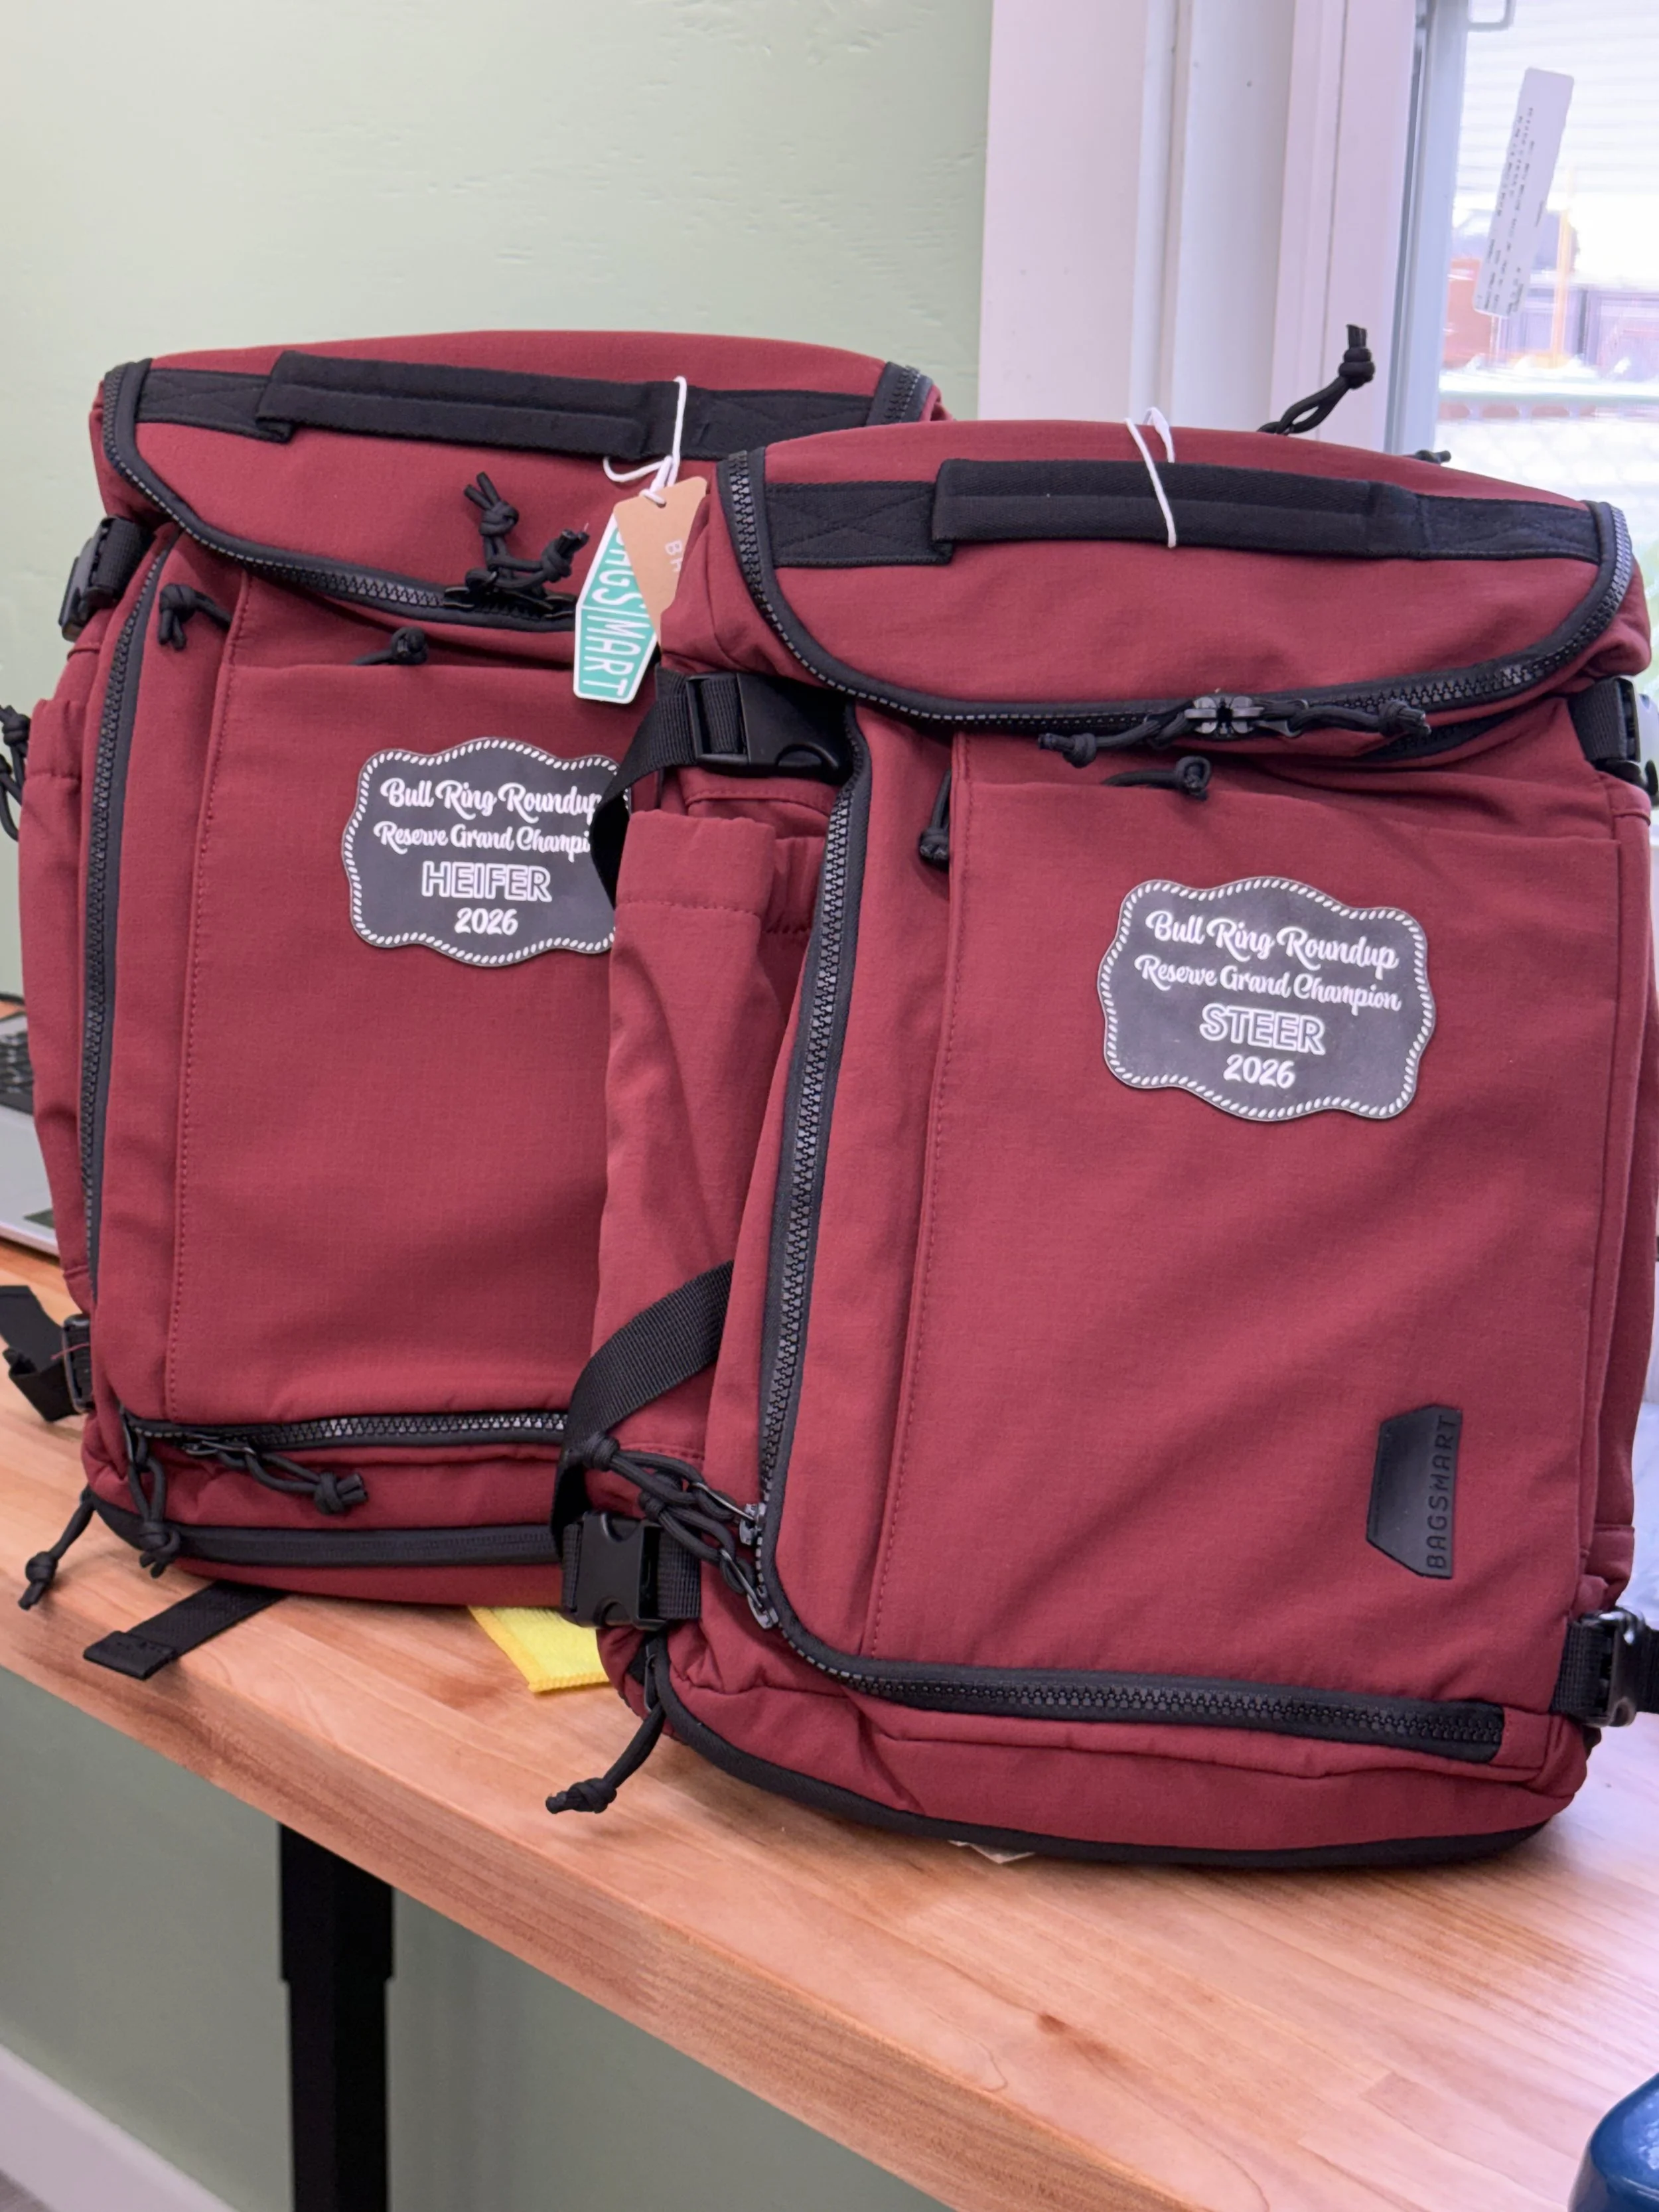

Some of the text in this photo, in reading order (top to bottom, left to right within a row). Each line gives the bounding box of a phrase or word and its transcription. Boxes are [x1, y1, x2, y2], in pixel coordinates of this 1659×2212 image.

[380, 777, 435, 808] Bull
[435, 780, 498, 820] Ring
[373, 820, 449, 855] Reserve
[450, 824, 515, 851] Grand
[421, 860, 553, 903] HEIFER
[454, 907, 518, 936] 2026
[1145, 909, 1400, 980] Bull Ring Roundup
[1133, 954, 1402, 1016] Reserve Grand Champion
[1198, 1002, 1326, 1056] STEER
[1223, 1053, 1296, 1089] 2026
[1425, 1414, 1459, 1570] BAGSMART
